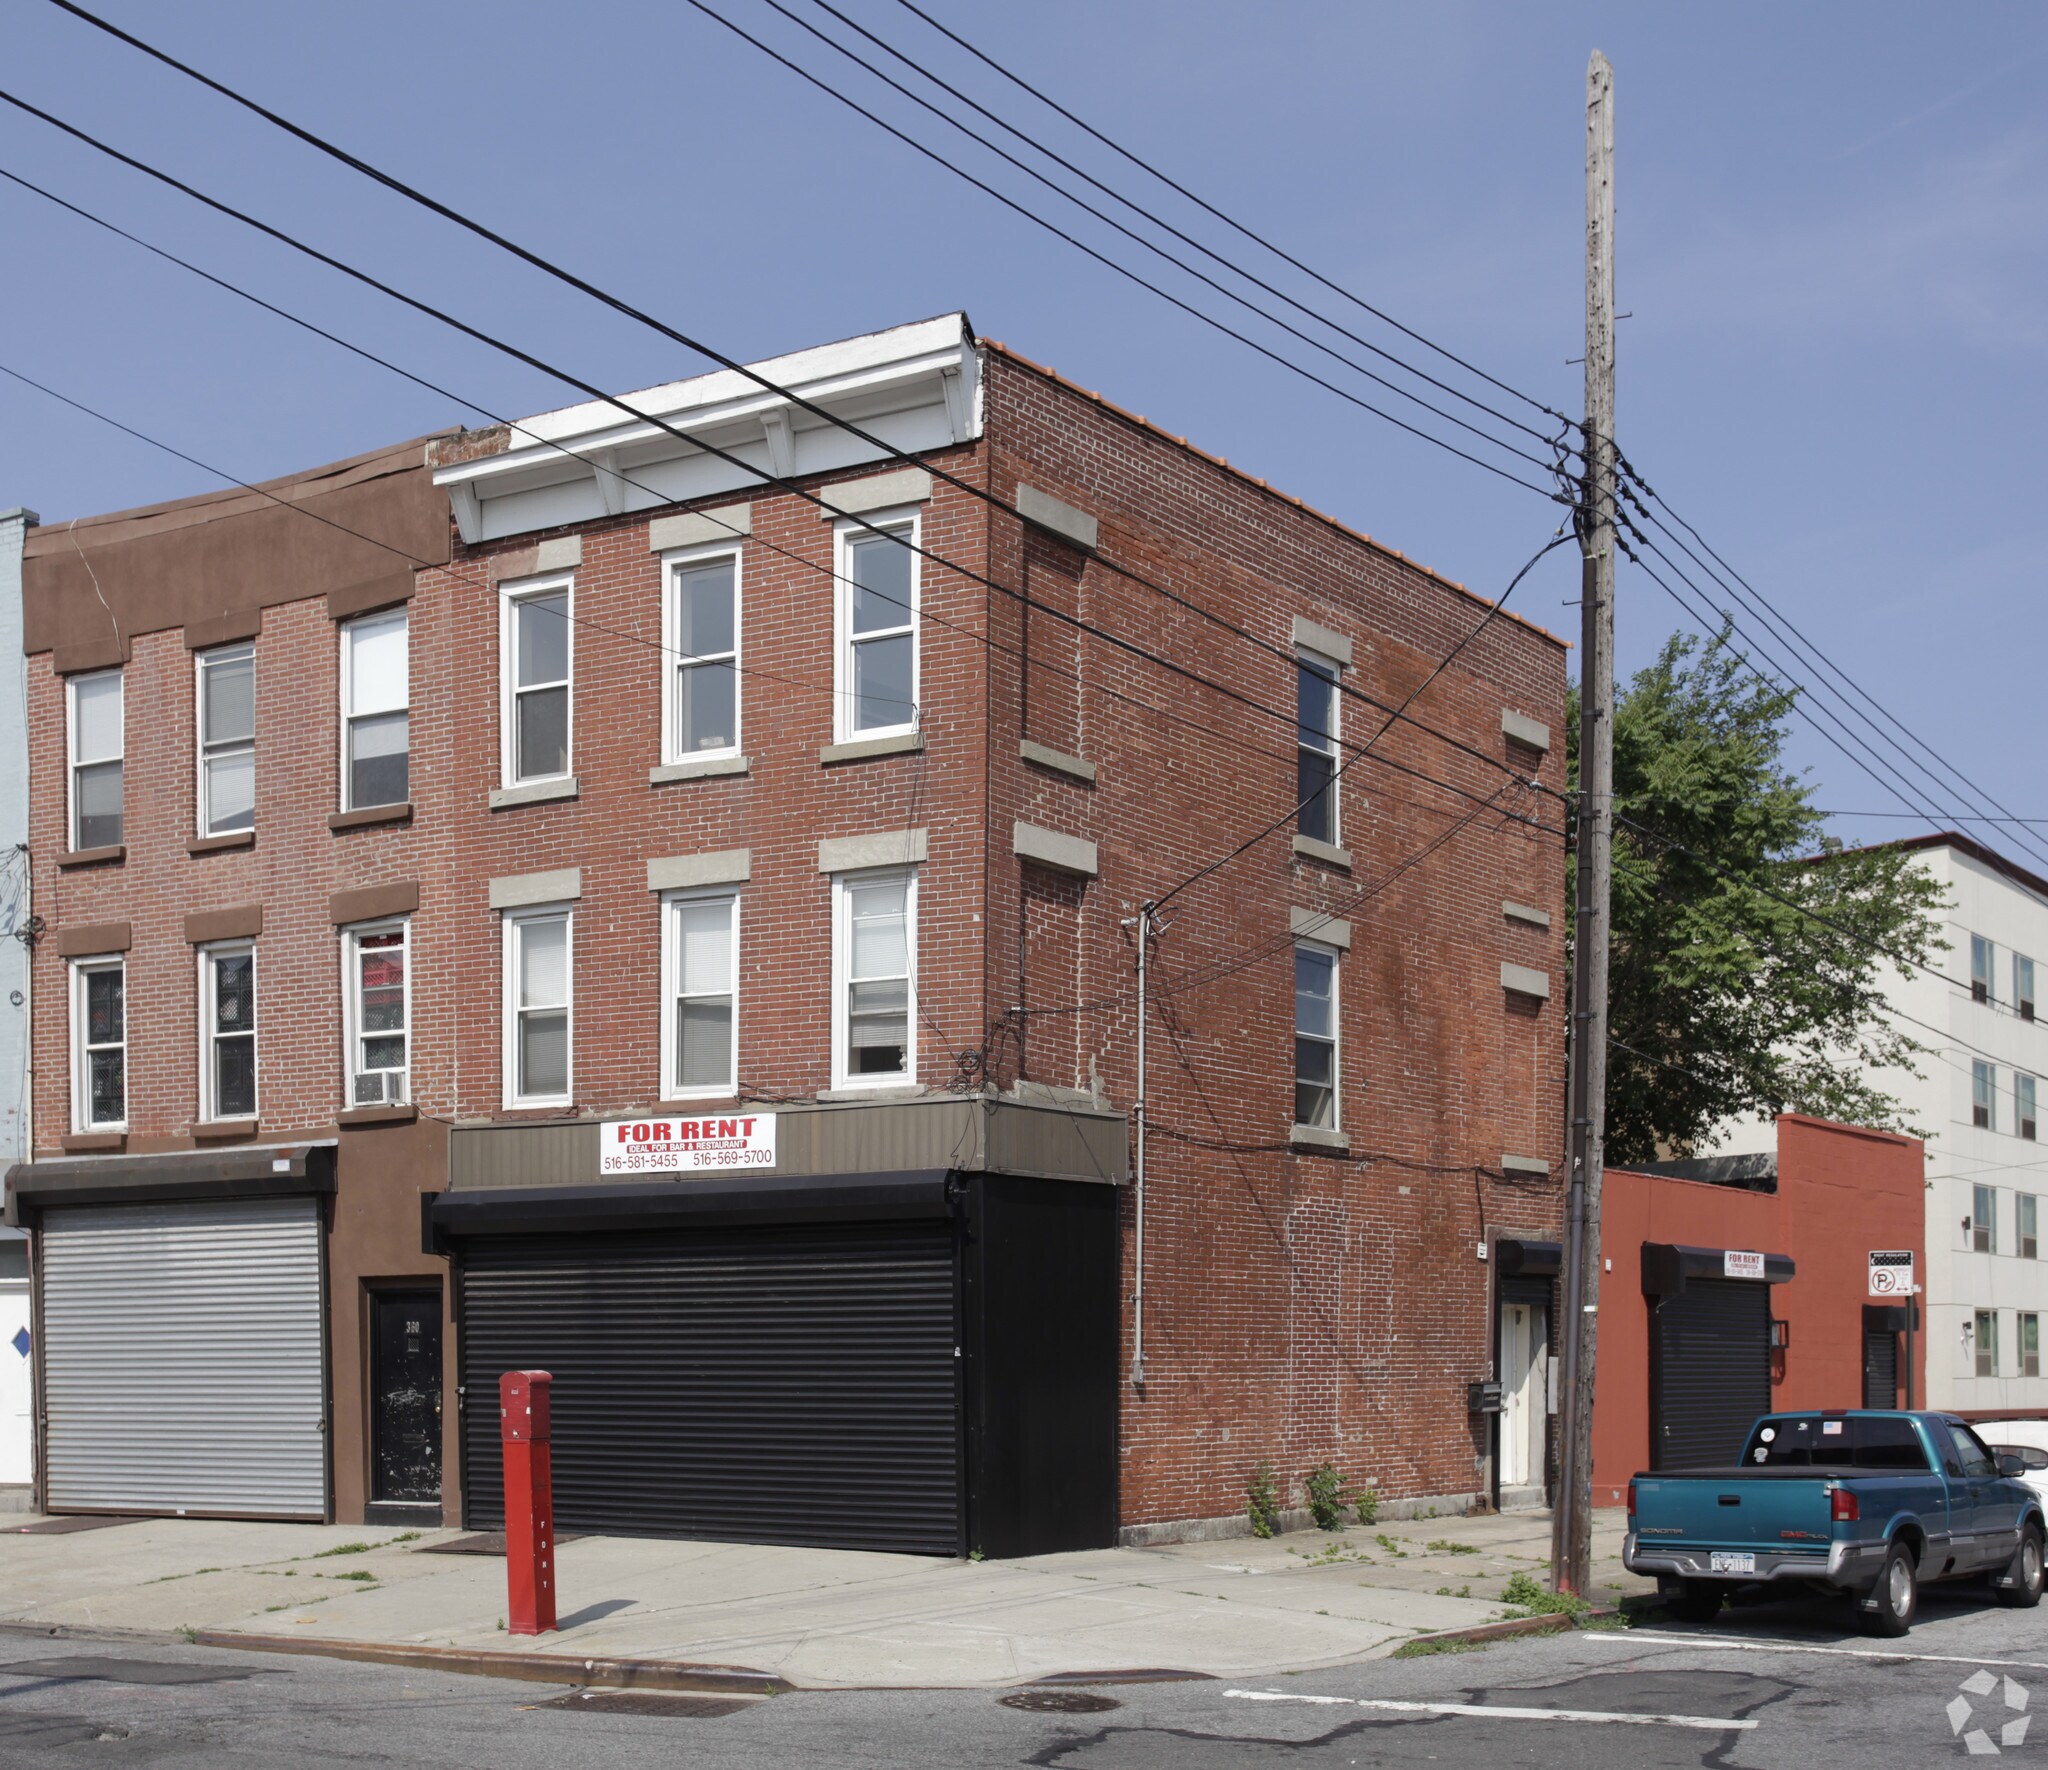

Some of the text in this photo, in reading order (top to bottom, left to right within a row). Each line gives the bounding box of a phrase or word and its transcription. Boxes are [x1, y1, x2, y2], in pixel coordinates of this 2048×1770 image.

[618, 1118, 757, 1143] FOR RENT
[629, 1140, 744, 1153] IDEAL FOR BAR & RESTAURANT
[604, 1149, 772, 1169] 516-581-5455 516-569-5700
[1729, 1254, 1760, 1264] FOR RENT
